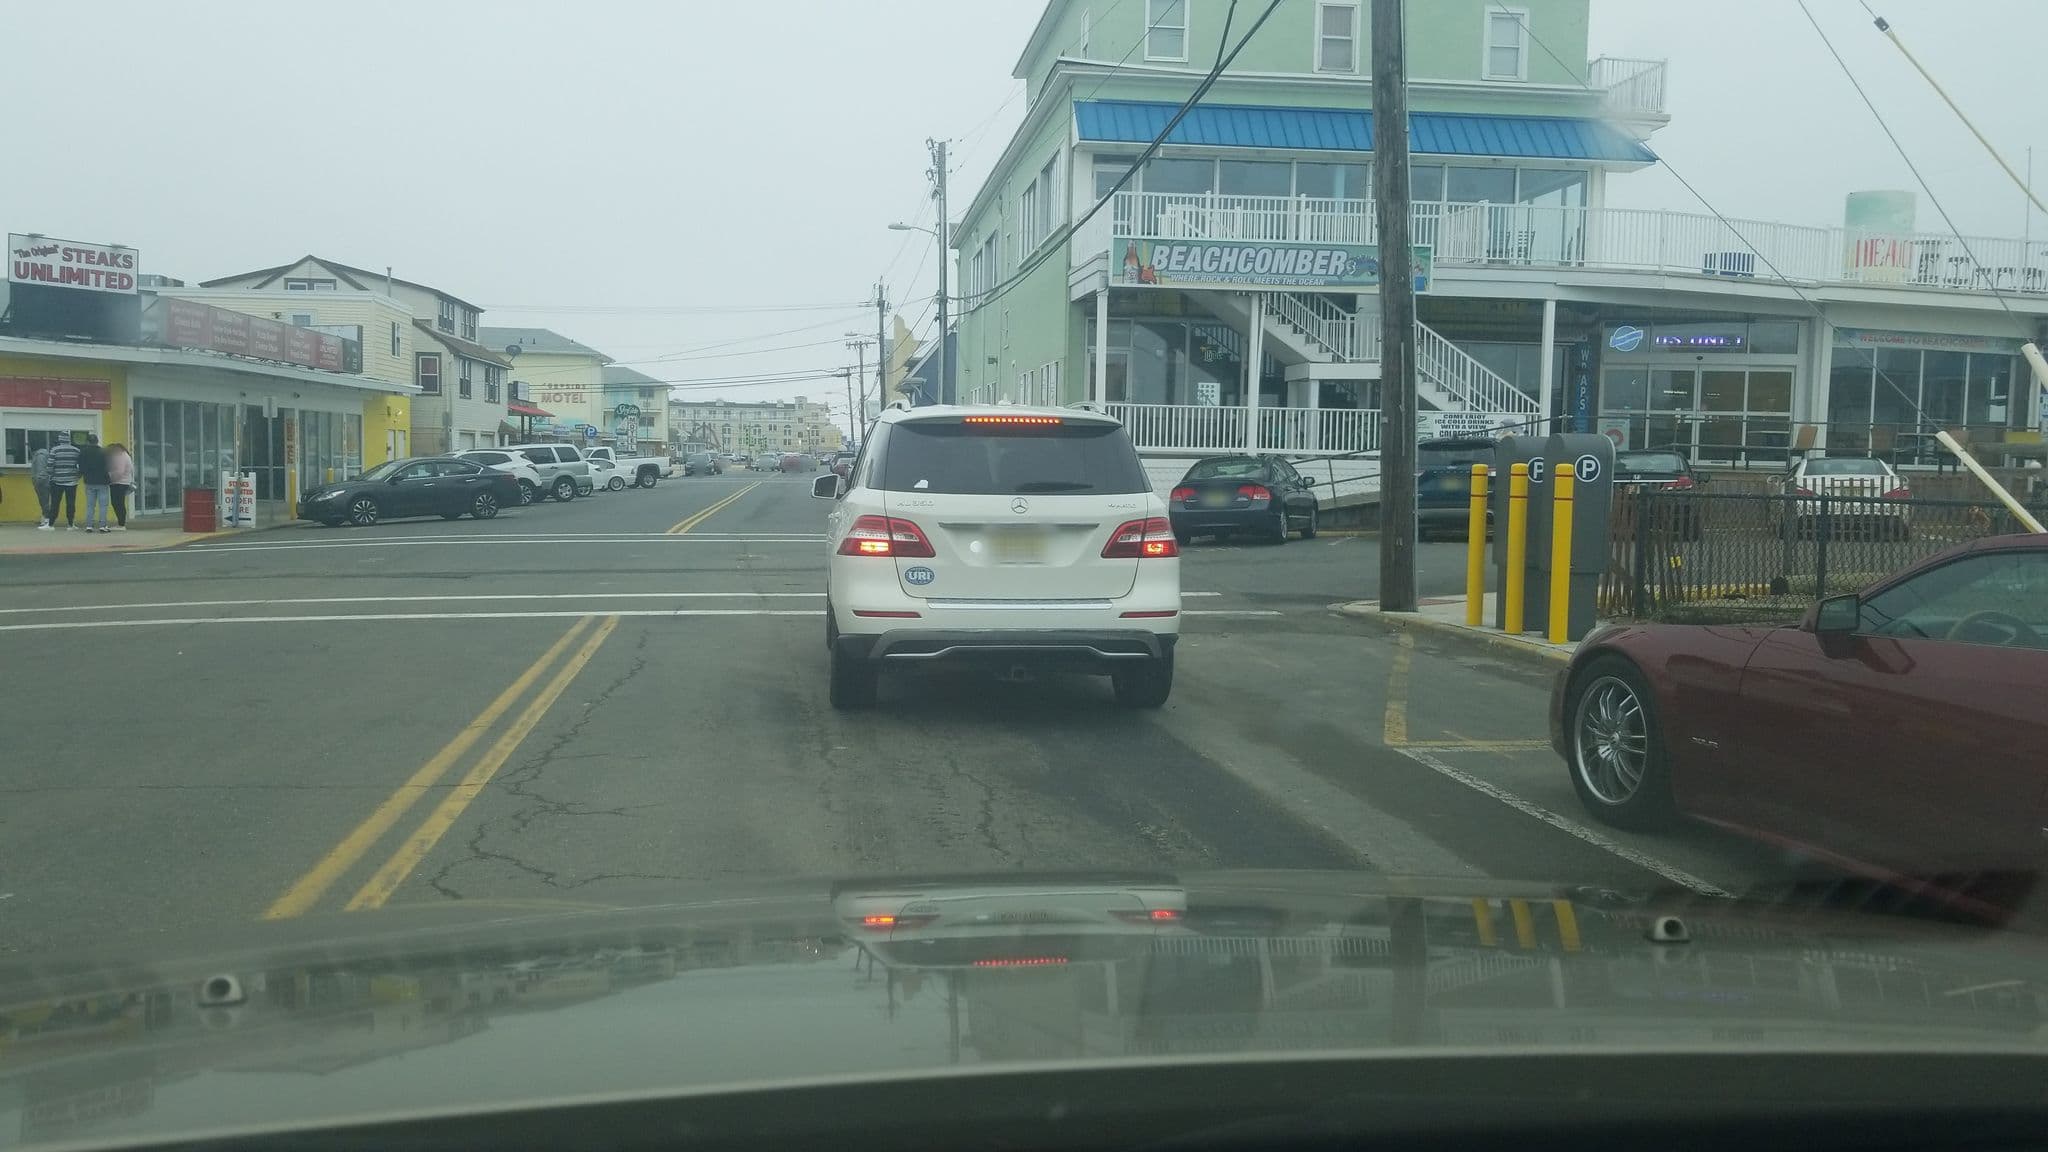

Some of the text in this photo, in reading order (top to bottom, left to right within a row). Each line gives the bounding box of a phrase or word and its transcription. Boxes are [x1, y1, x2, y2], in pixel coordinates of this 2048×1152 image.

[62, 247, 133, 269] STEAKS
[14, 261, 134, 290] UNLIMITED
[1170, 273, 1198, 283] WHERE
[1199, 274, 1221, 284] ROCK
[1231, 276, 1251, 285] ROLL
[1252, 276, 1281, 285] MEETS
[1281, 277, 1297, 286] THE
[1298, 278, 1325, 286] OCEAN
[541, 391, 587, 404] MOTEL
[908, 570, 932, 580] URI
